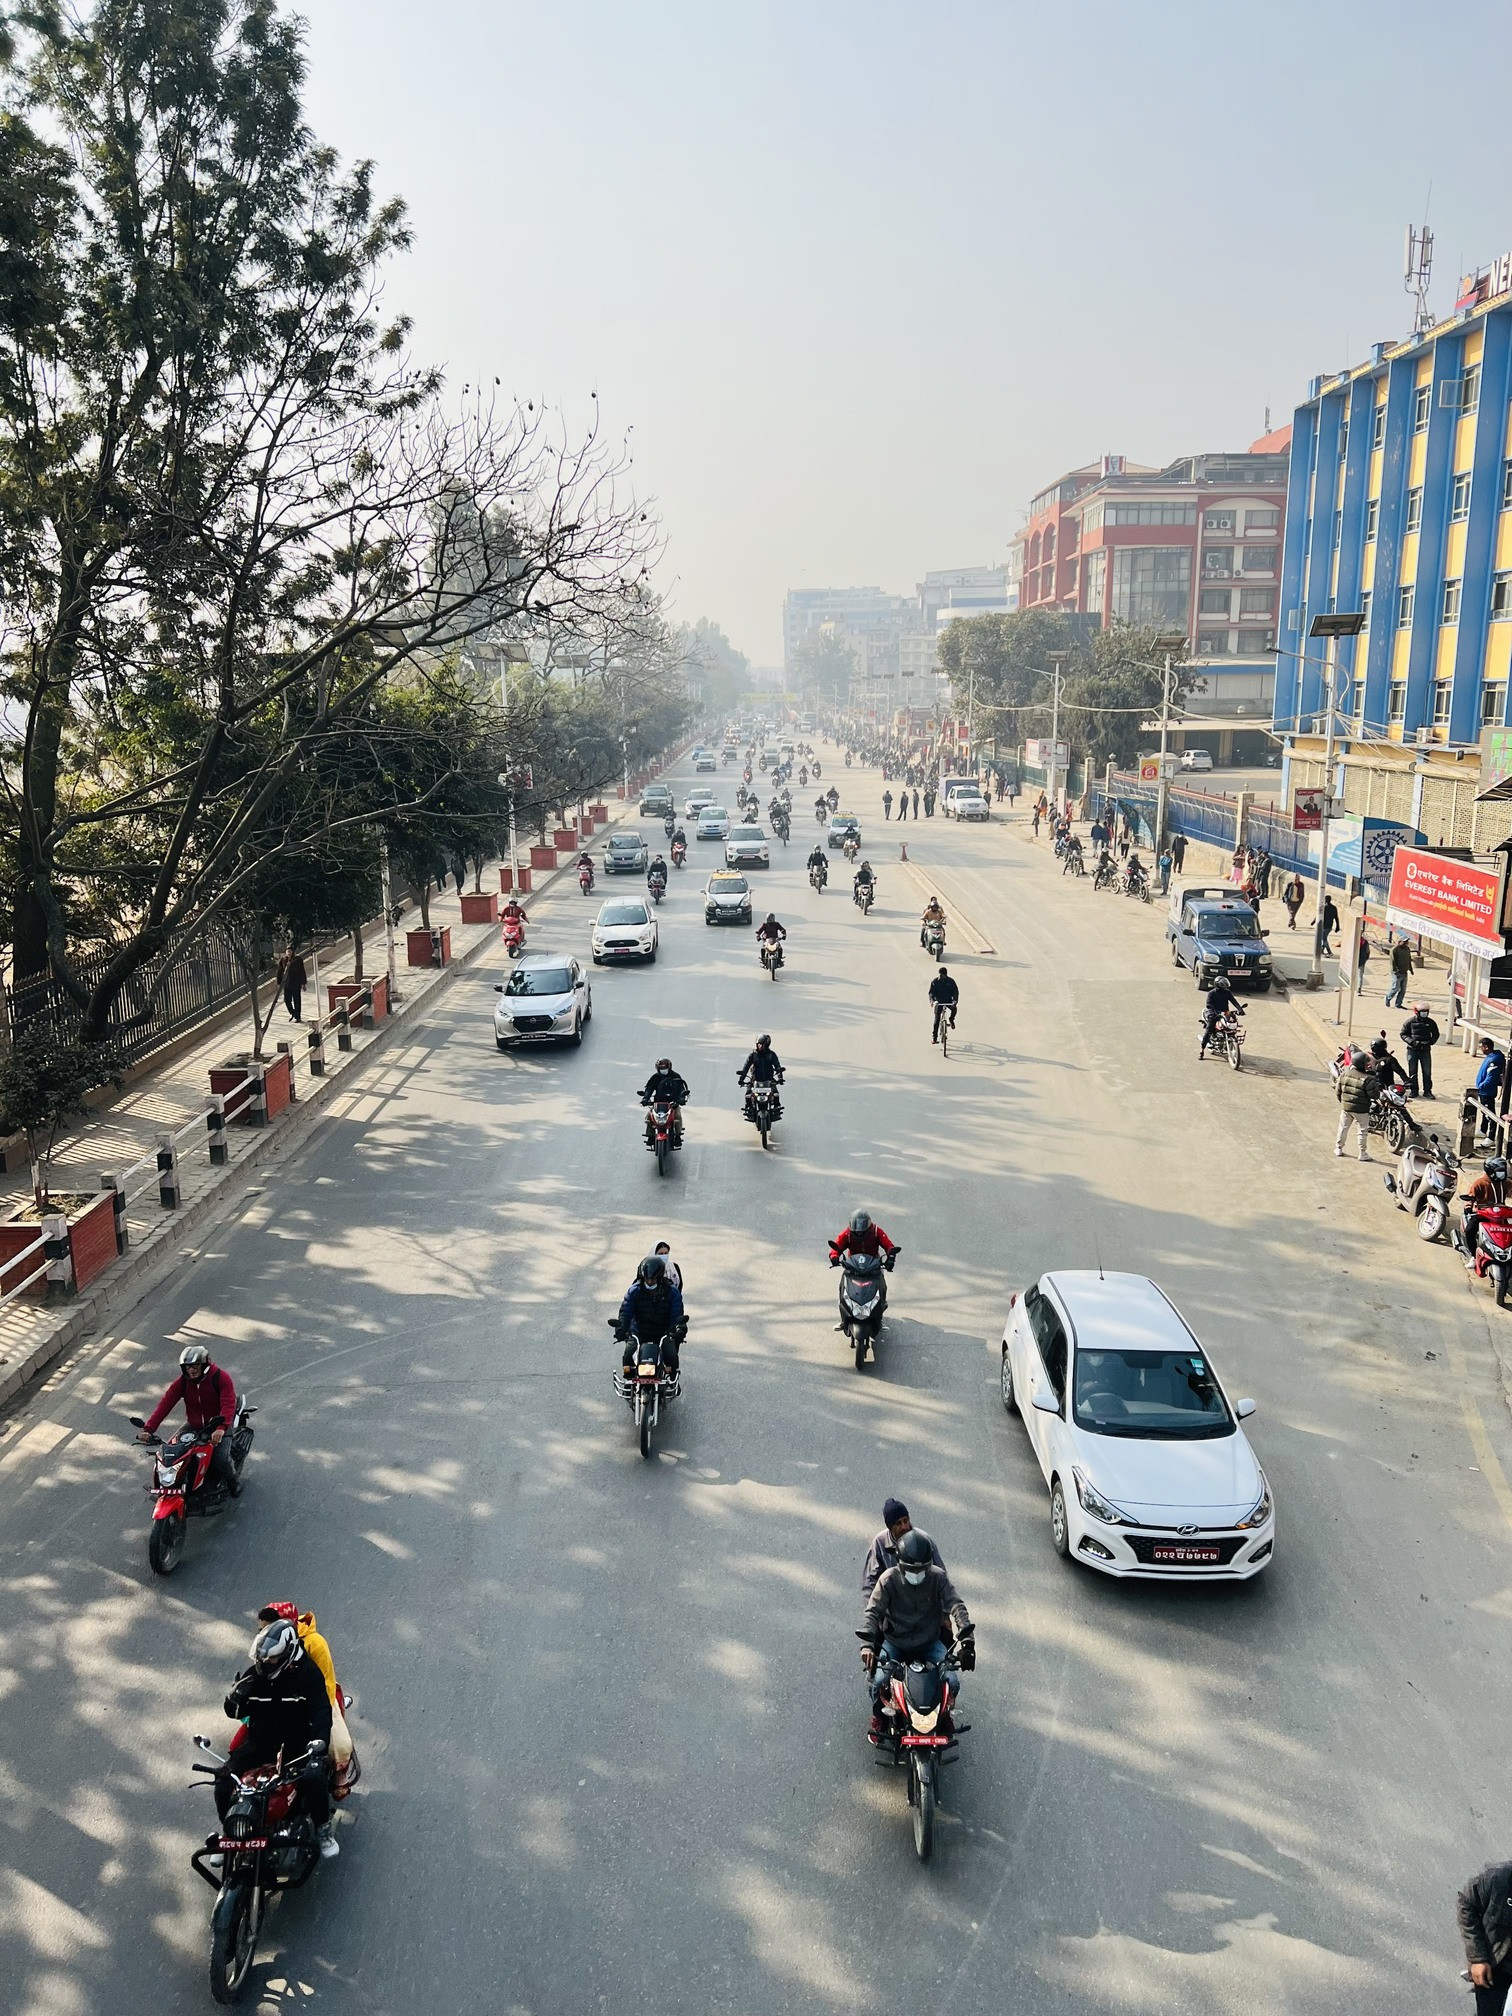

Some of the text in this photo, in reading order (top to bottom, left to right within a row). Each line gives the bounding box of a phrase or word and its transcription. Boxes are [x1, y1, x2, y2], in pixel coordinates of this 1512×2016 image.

[1404, 879, 1437, 896] EVEREST
[1437, 890, 1460, 904] BANK
[1460, 897, 1492, 914] LIMITED
